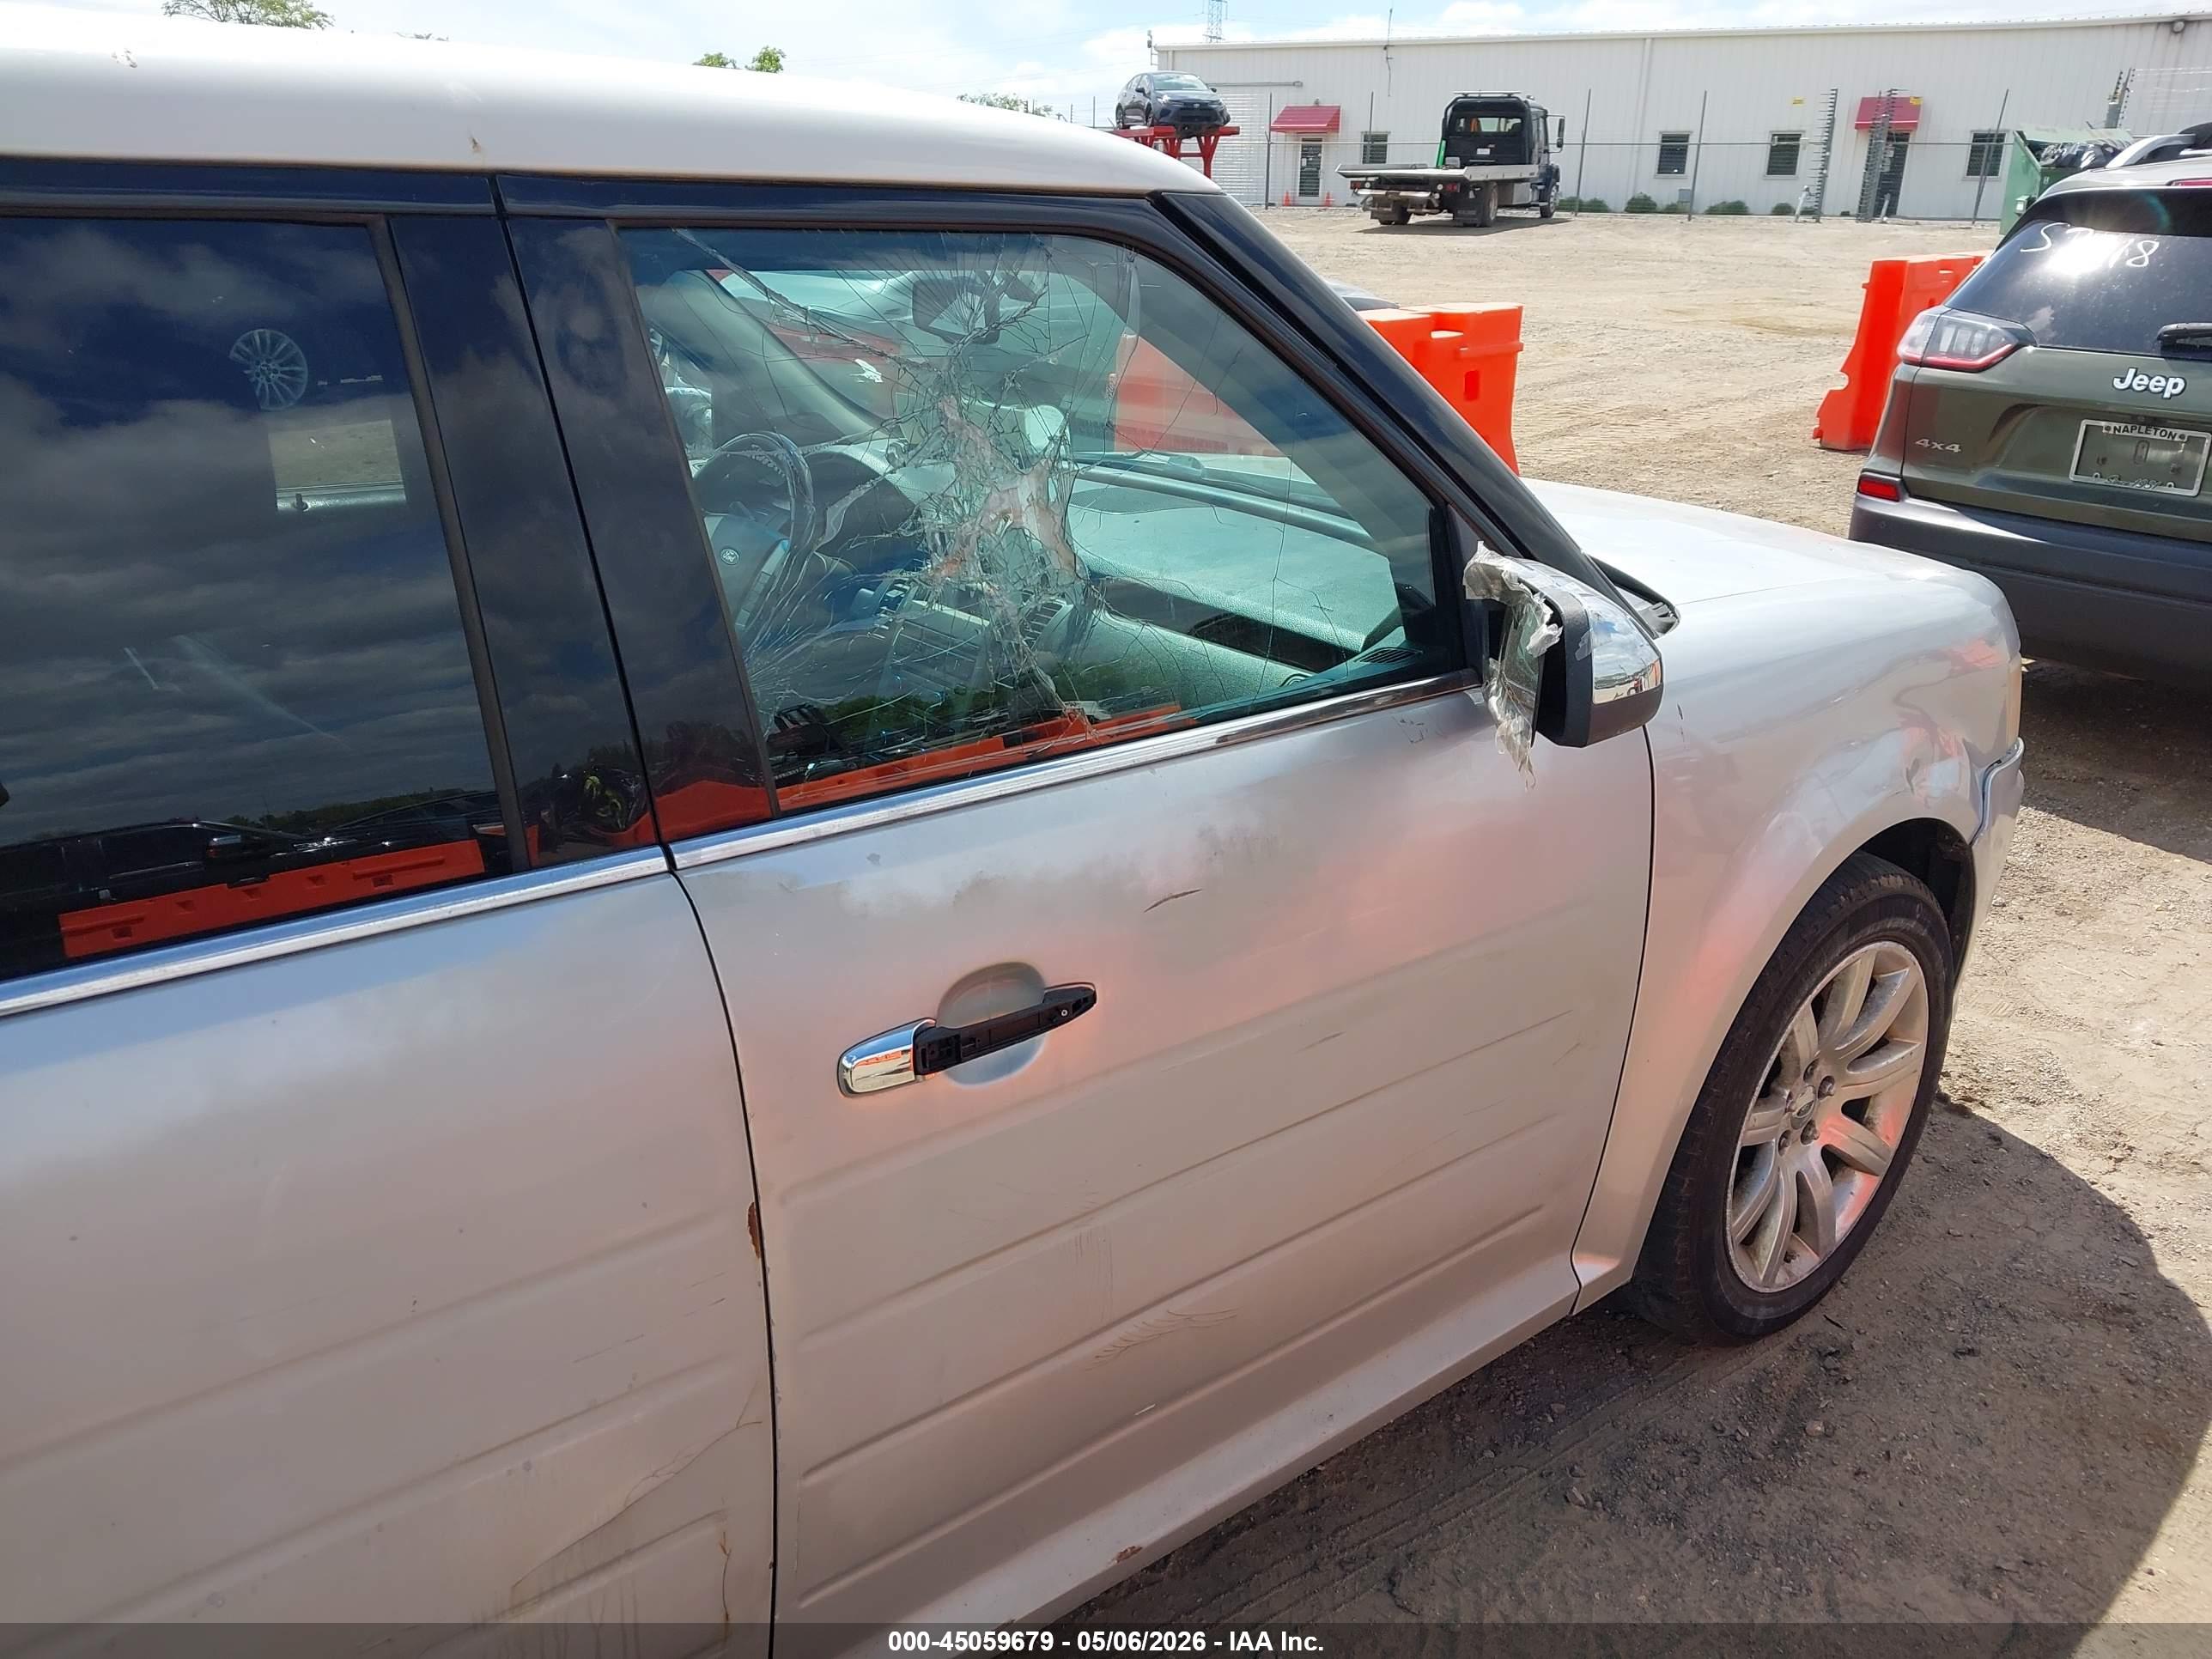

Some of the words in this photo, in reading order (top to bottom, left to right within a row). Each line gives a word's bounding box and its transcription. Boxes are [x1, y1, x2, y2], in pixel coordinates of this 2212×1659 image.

[2112, 368, 2186, 399] Jeep
[2112, 425, 2178, 441] NAPLETON
[1915, 438, 1962, 453] 4x4
